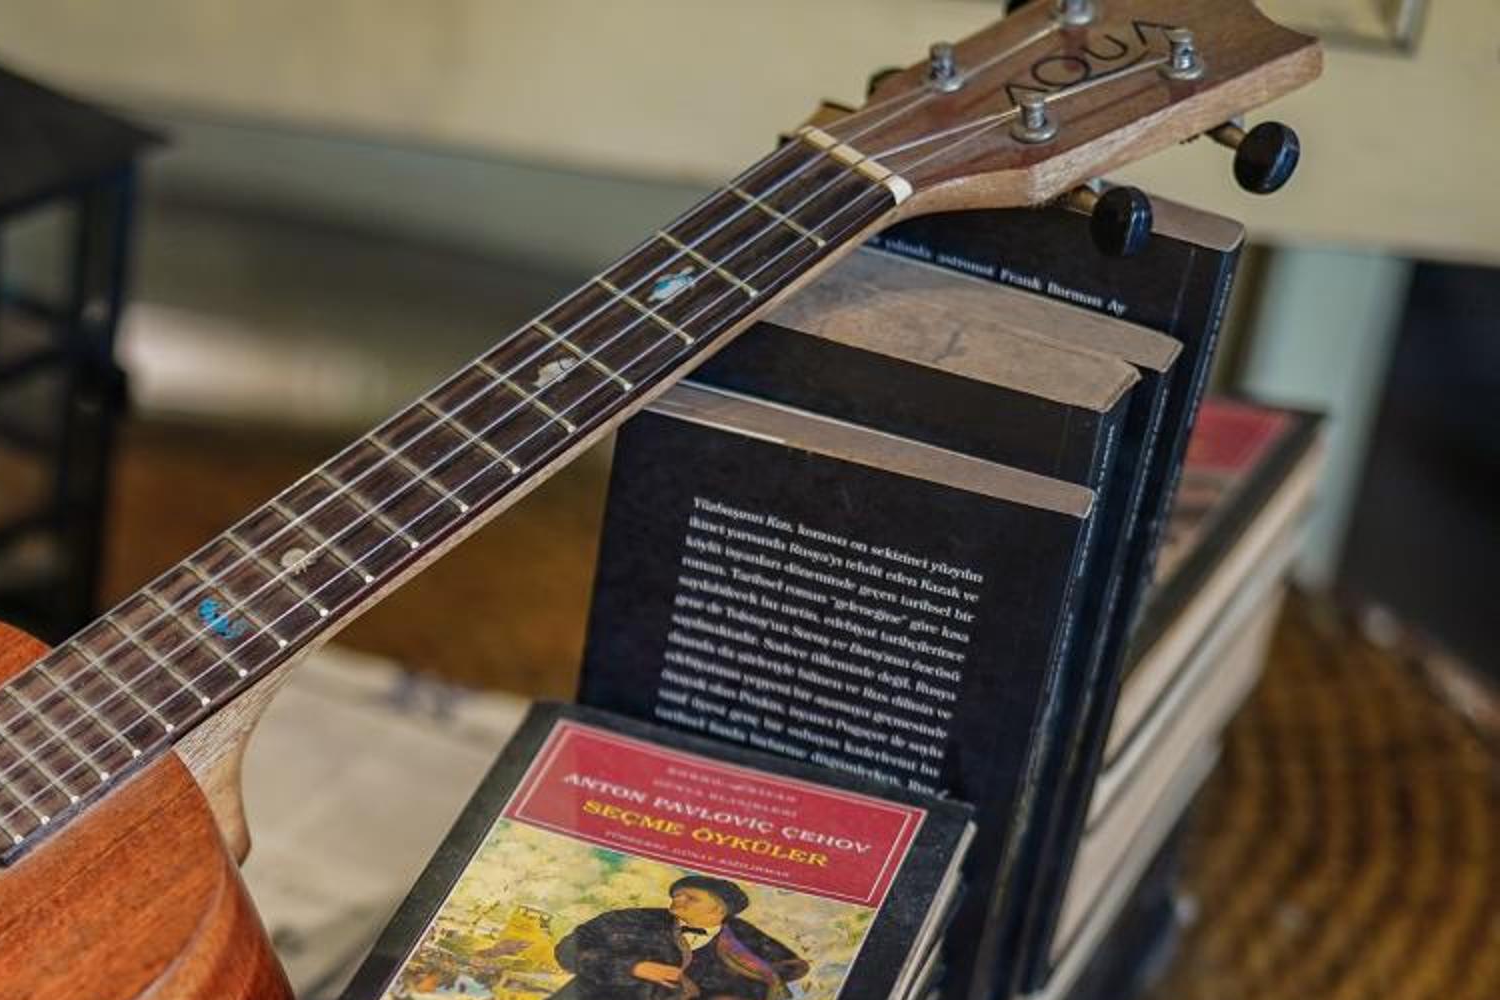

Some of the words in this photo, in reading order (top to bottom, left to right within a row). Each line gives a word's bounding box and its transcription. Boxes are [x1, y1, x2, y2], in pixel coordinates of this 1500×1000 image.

[1005, 20, 1184, 107] AQUA
[848, 540, 868, 553] on
[953, 607, 976, 623] bir
[962, 590, 979, 603] ve
[562, 772, 647, 802] ANTON
[652, 796, 774, 832] PAVLOVİÇ
[778, 824, 872, 854] ÇEHOV
[581, 800, 684, 837] SEÇME
[689, 823, 830, 869] ÖYKÜLER
